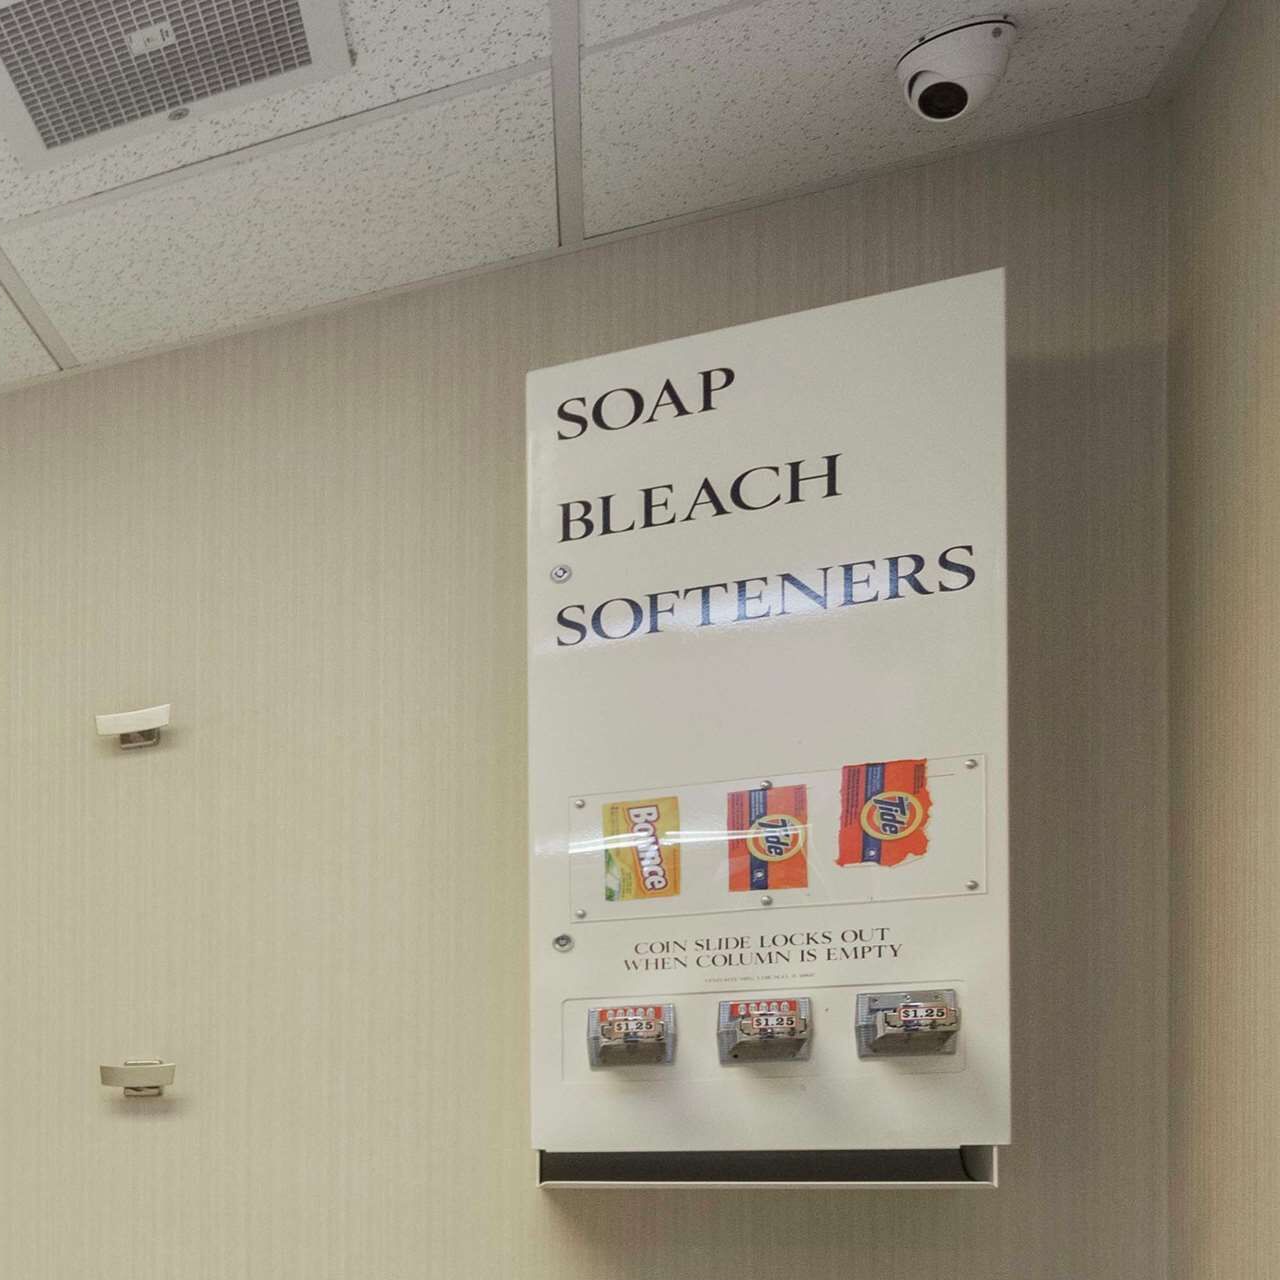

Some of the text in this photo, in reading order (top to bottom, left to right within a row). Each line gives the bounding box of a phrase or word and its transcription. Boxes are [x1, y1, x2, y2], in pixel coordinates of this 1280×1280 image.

[556, 367, 736, 441] SOAP
[557, 453, 843, 543] BLEACH
[555, 545, 977, 647] SOFTENERS
[872, 795, 907, 835] Tide
[628, 805, 668, 891] Bounce
[757, 818, 790, 857] Tide
[624, 943, 903, 972] WHEN COLUMN IS EMPTY
[634, 927, 890, 955] COIN SLIDE LOCKS OUT
[616, 1020, 653, 1031] $1.25
[754, 1016, 794, 1027] $1.25
[902, 1008, 945, 1018] $1.25
